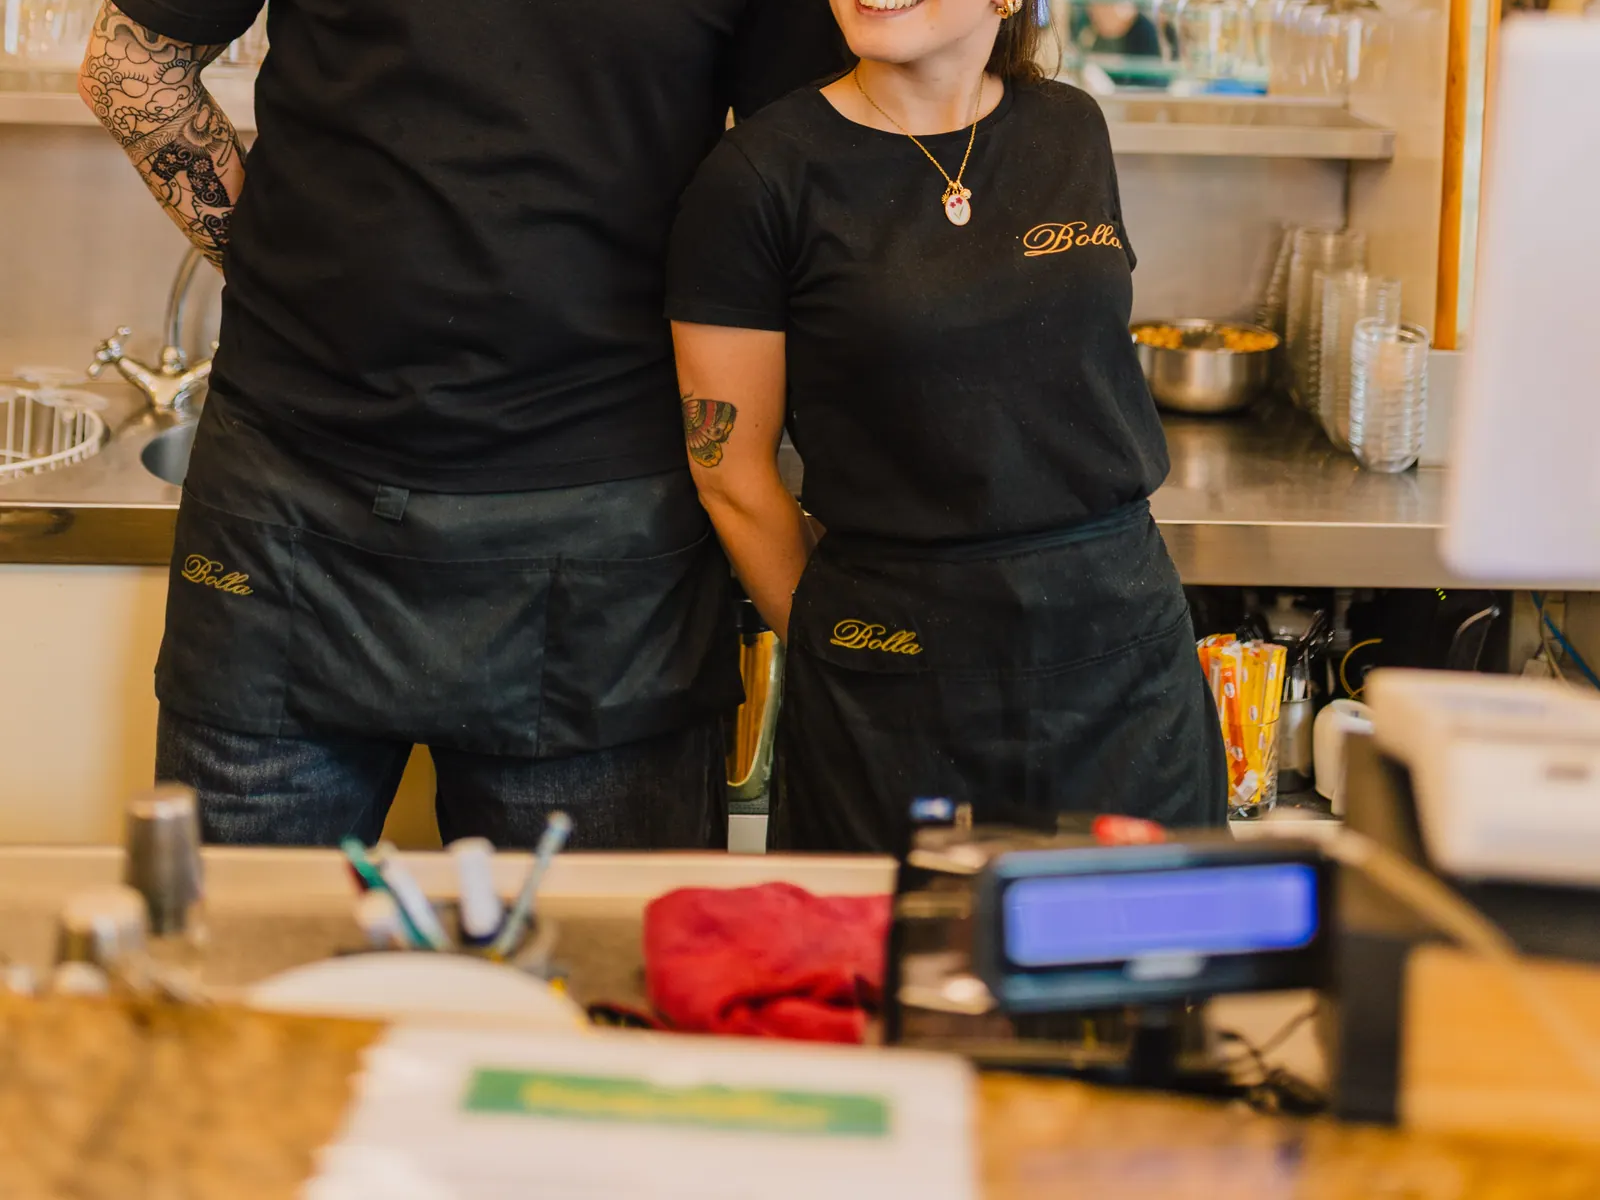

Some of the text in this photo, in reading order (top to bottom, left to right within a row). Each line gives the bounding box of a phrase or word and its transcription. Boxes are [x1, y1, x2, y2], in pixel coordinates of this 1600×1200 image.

[1023, 221, 1122, 257] Bolla
[181, 554, 254, 596] Bolla
[829, 619, 923, 655] Bolla
